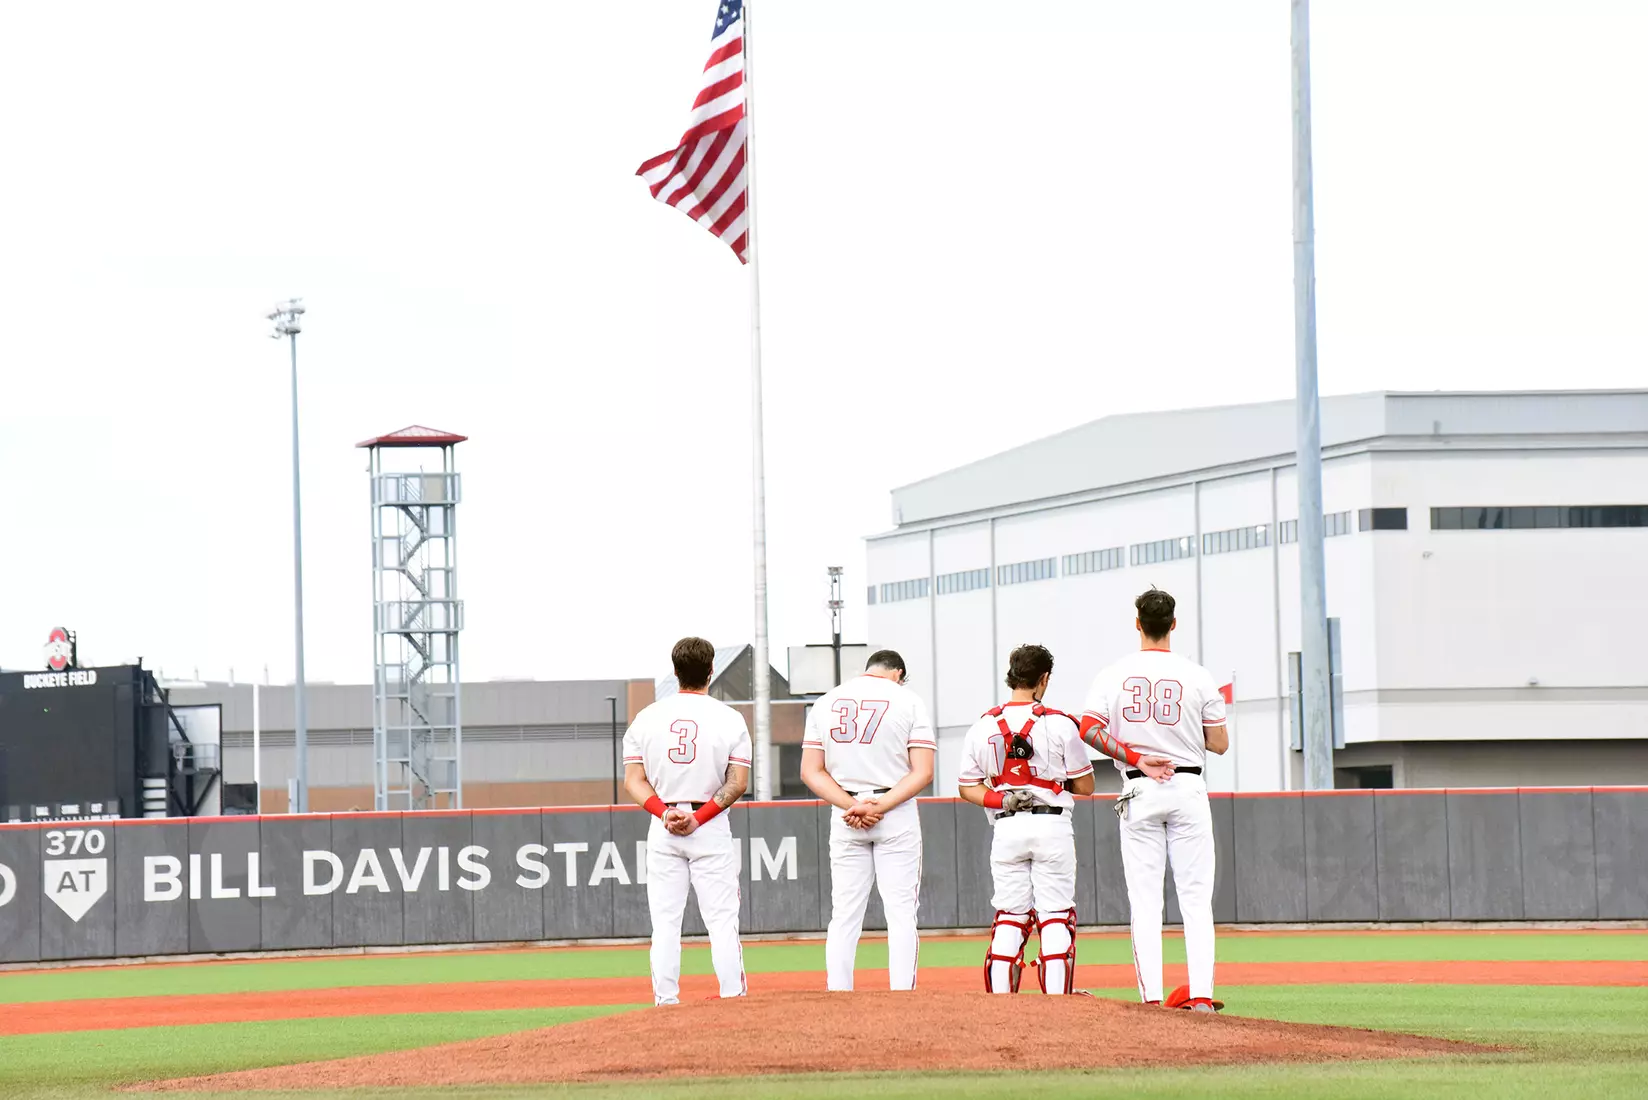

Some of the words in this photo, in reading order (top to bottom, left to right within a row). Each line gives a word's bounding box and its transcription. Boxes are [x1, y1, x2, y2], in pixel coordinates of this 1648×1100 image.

[23, 672, 68, 689] BUCKEYE
[68, 670, 97, 687] FIELD
[1122, 676, 1183, 726] 38
[668, 719, 698, 764] 3
[830, 698, 890, 744] 37
[45, 829, 105, 856] 370
[56, 869, 96, 893] AT
[143, 851, 277, 902] BILL
[302, 845, 492, 896] DAVIS
[515, 836, 798, 889] STAM
